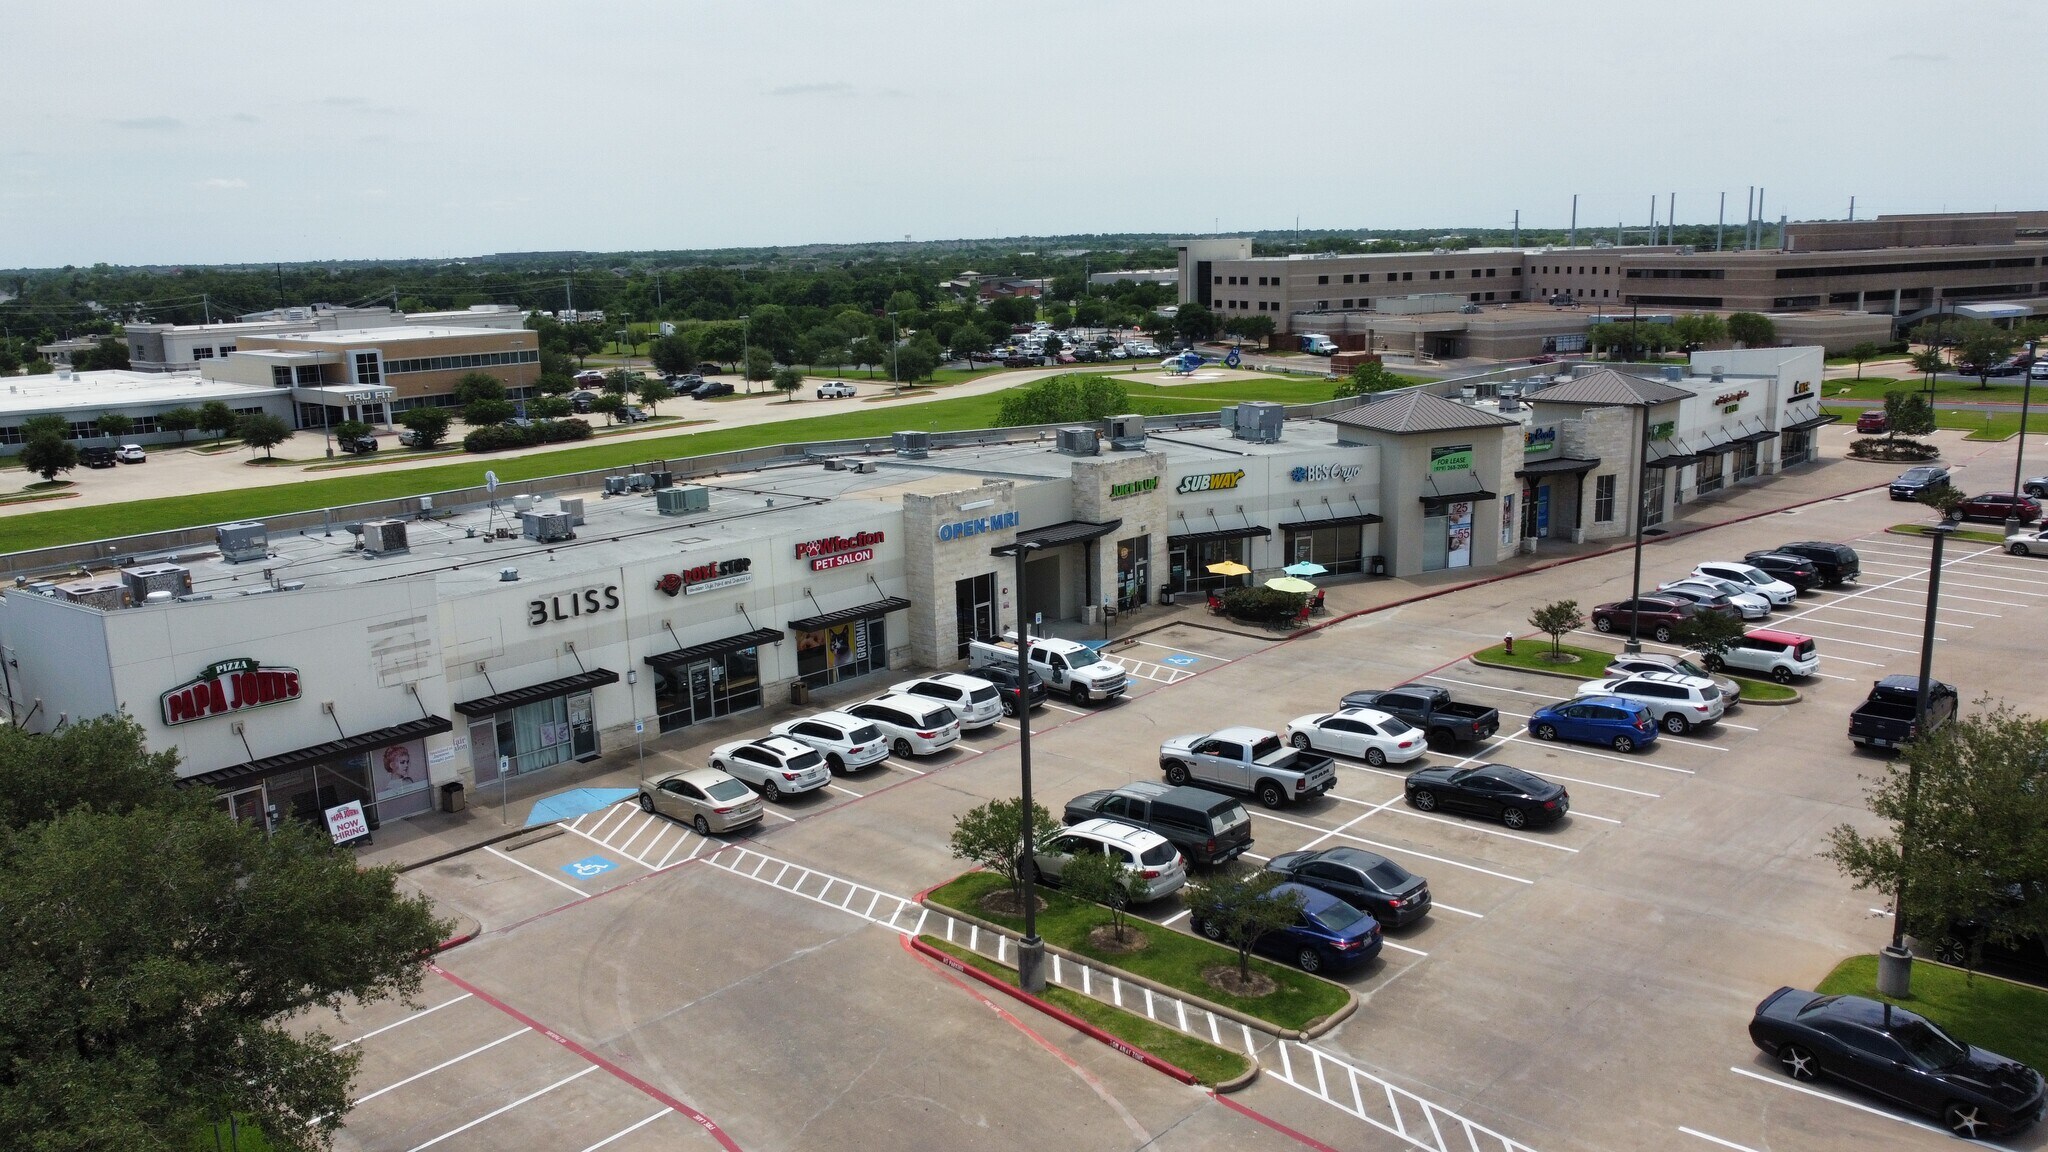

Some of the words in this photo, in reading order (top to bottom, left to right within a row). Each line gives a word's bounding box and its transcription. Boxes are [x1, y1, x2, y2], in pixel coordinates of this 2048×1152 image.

[346, 392, 370, 402] TRU
[375, 390, 392, 398] FIT
[1306, 465, 1328, 482] BCS
[1330, 463, 1360, 482] Cryo
[1176, 469, 1245, 494] SUBWAY
[1110, 484, 1135, 498] JUICE
[938, 518, 986, 542] OPEN
[990, 510, 1020, 531] MRI
[720, 558, 752, 576] STOP
[816, 558, 834, 570] PET
[836, 550, 870, 566] SALON
[216, 660, 248, 674] PIZZA
[168, 678, 228, 722] PAPA
[1312, 768, 1330, 781] RAM
[334, 826, 366, 840] HIRING
[336, 818, 359, 832] NOW
